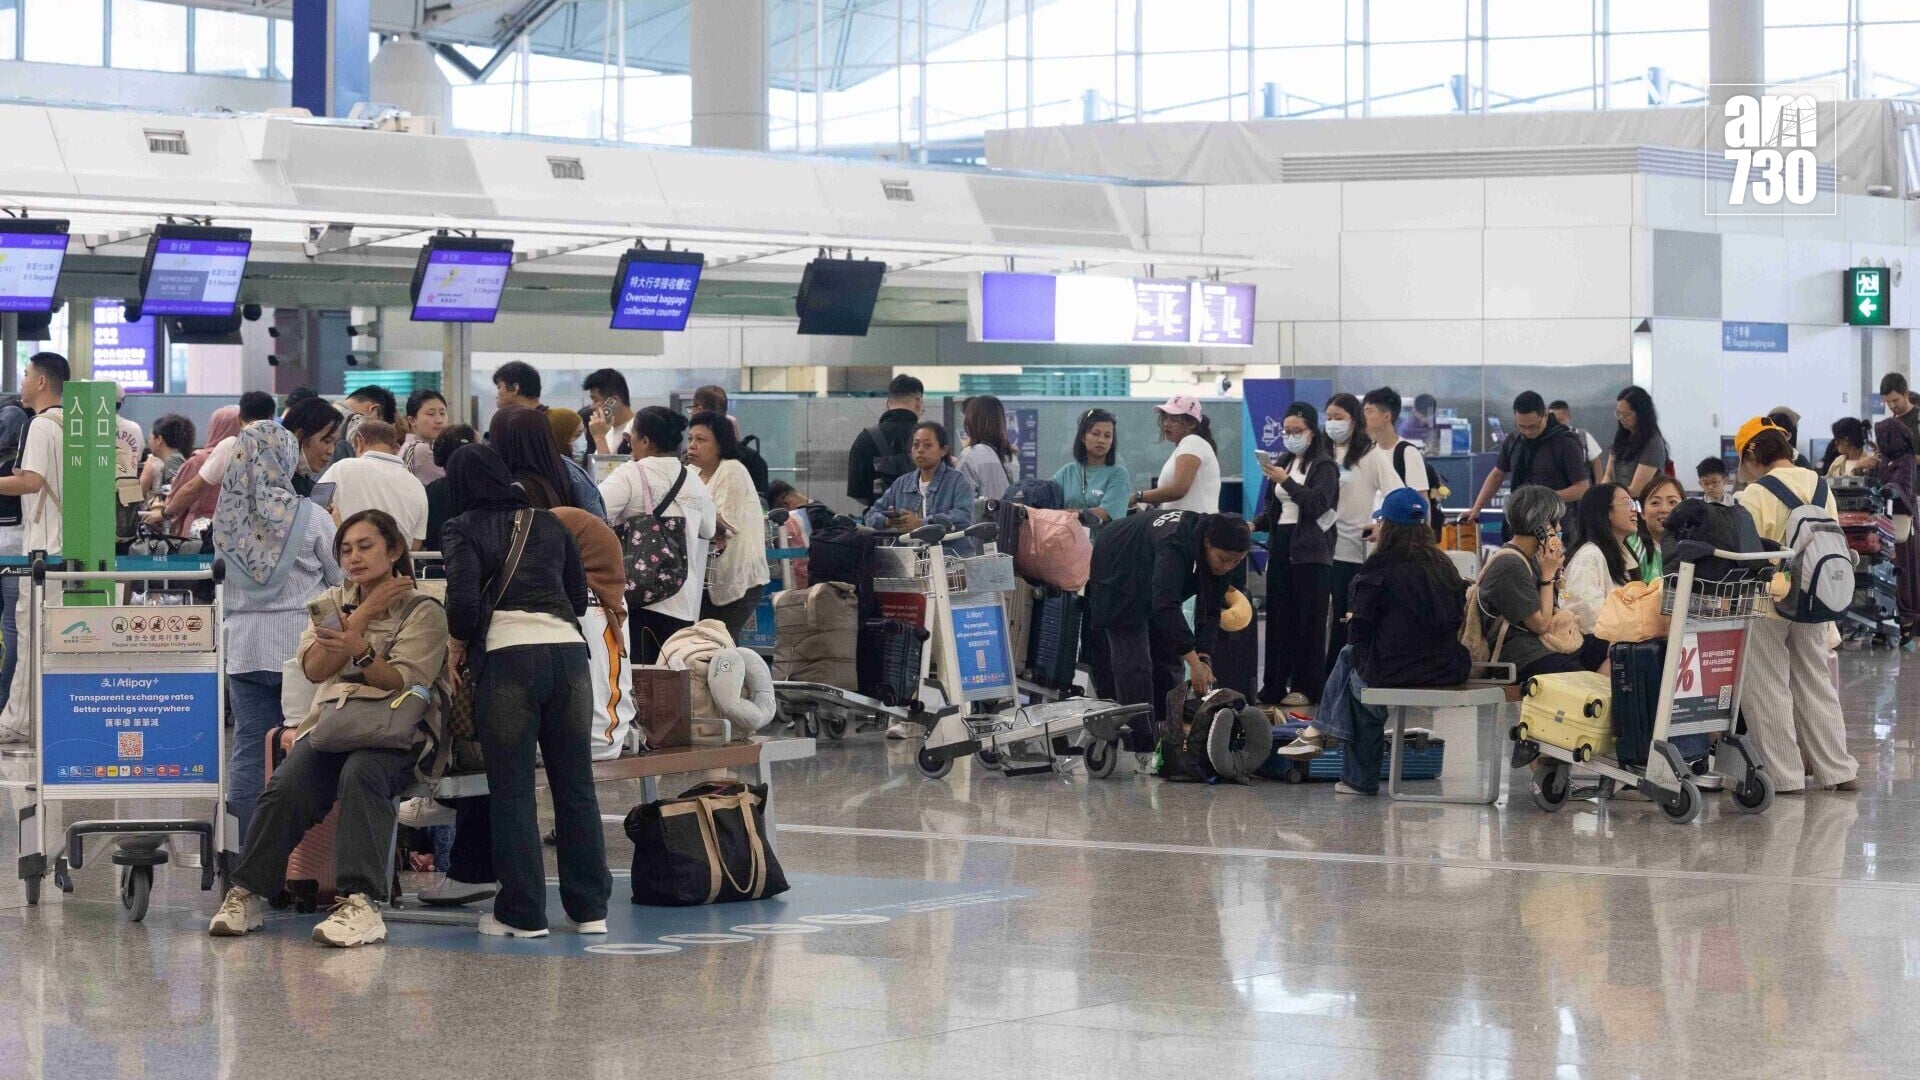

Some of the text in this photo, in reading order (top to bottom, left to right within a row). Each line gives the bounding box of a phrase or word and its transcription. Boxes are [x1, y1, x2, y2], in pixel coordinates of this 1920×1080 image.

[625, 292, 687, 306] Oversized baggage
[623, 306, 681, 317] collection counter
[69, 395, 85, 437] 入口
[96, 395, 111, 437] 入口
[71, 455, 82, 467] IN
[98, 455, 108, 467] IN
[69, 693, 194, 703] Transparent exchange rates
[73, 704, 191, 715] Better savings everywhere
[191, 764, 204, 774] 48
